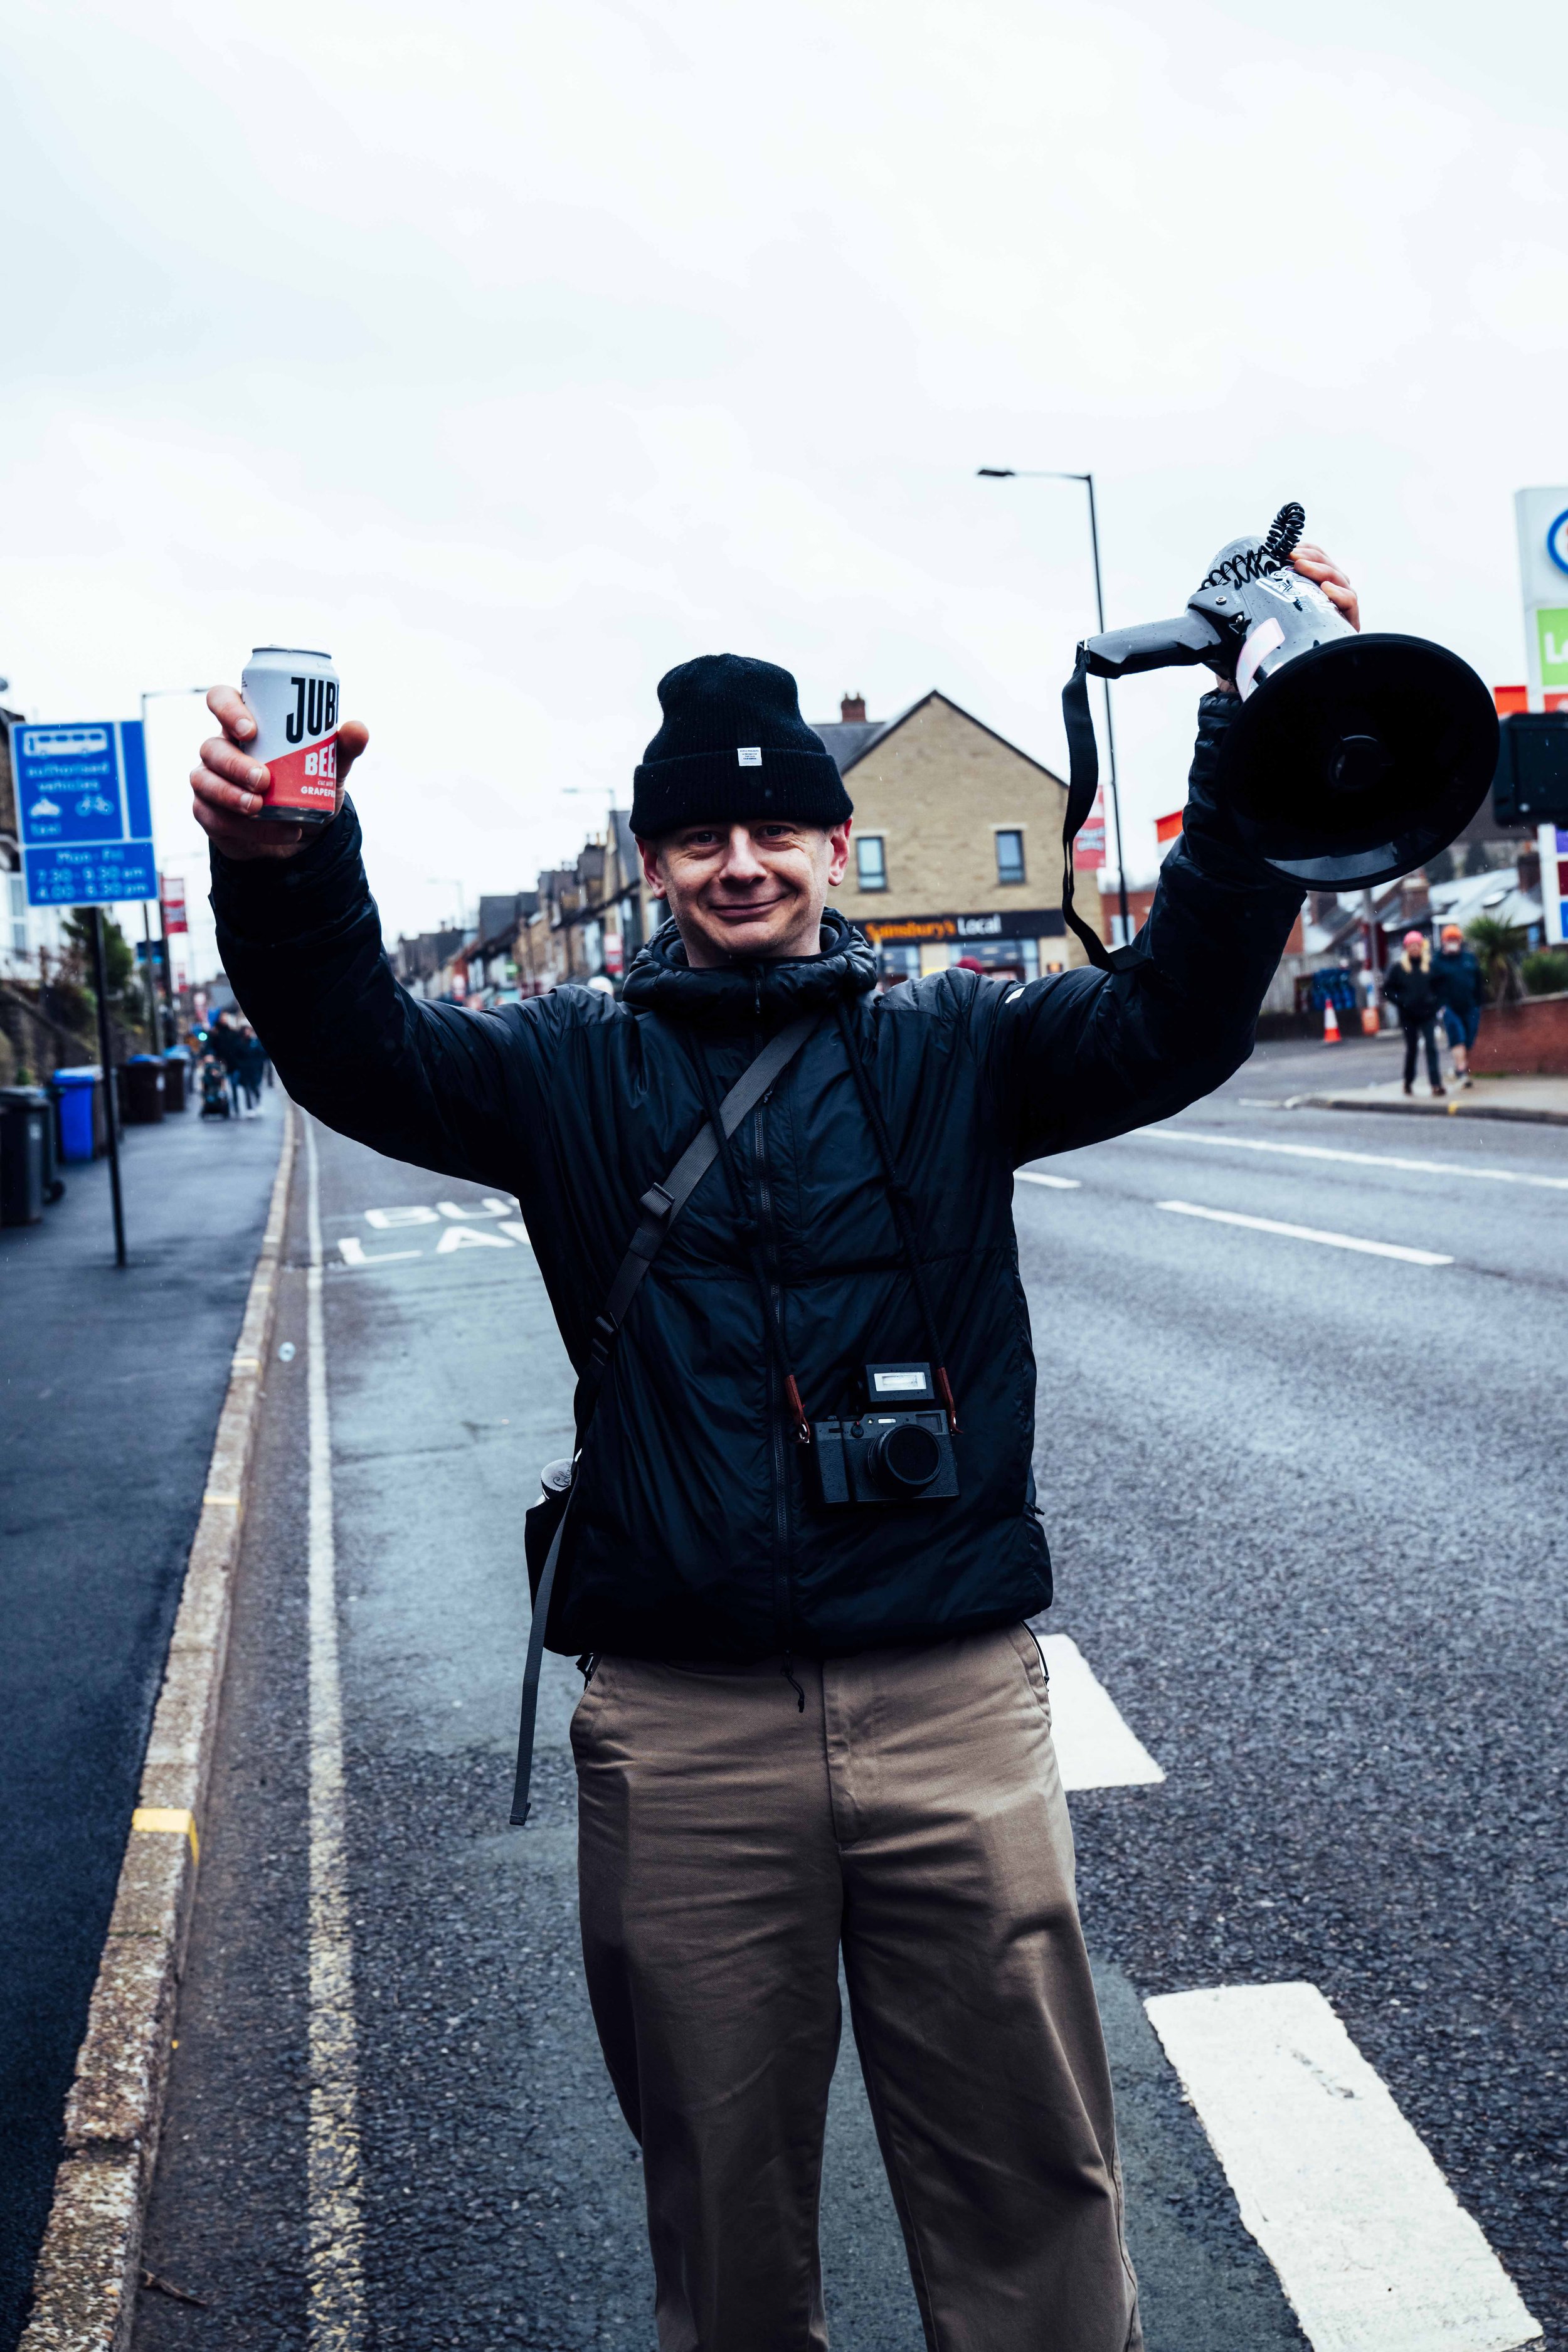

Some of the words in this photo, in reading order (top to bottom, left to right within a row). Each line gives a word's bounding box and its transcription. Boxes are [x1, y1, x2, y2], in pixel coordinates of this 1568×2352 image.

[286, 677, 339, 744] JUB
[305, 743, 337, 779] BEE
[957, 913, 1002, 936] Local
[364, 1197, 520, 1229] BU
